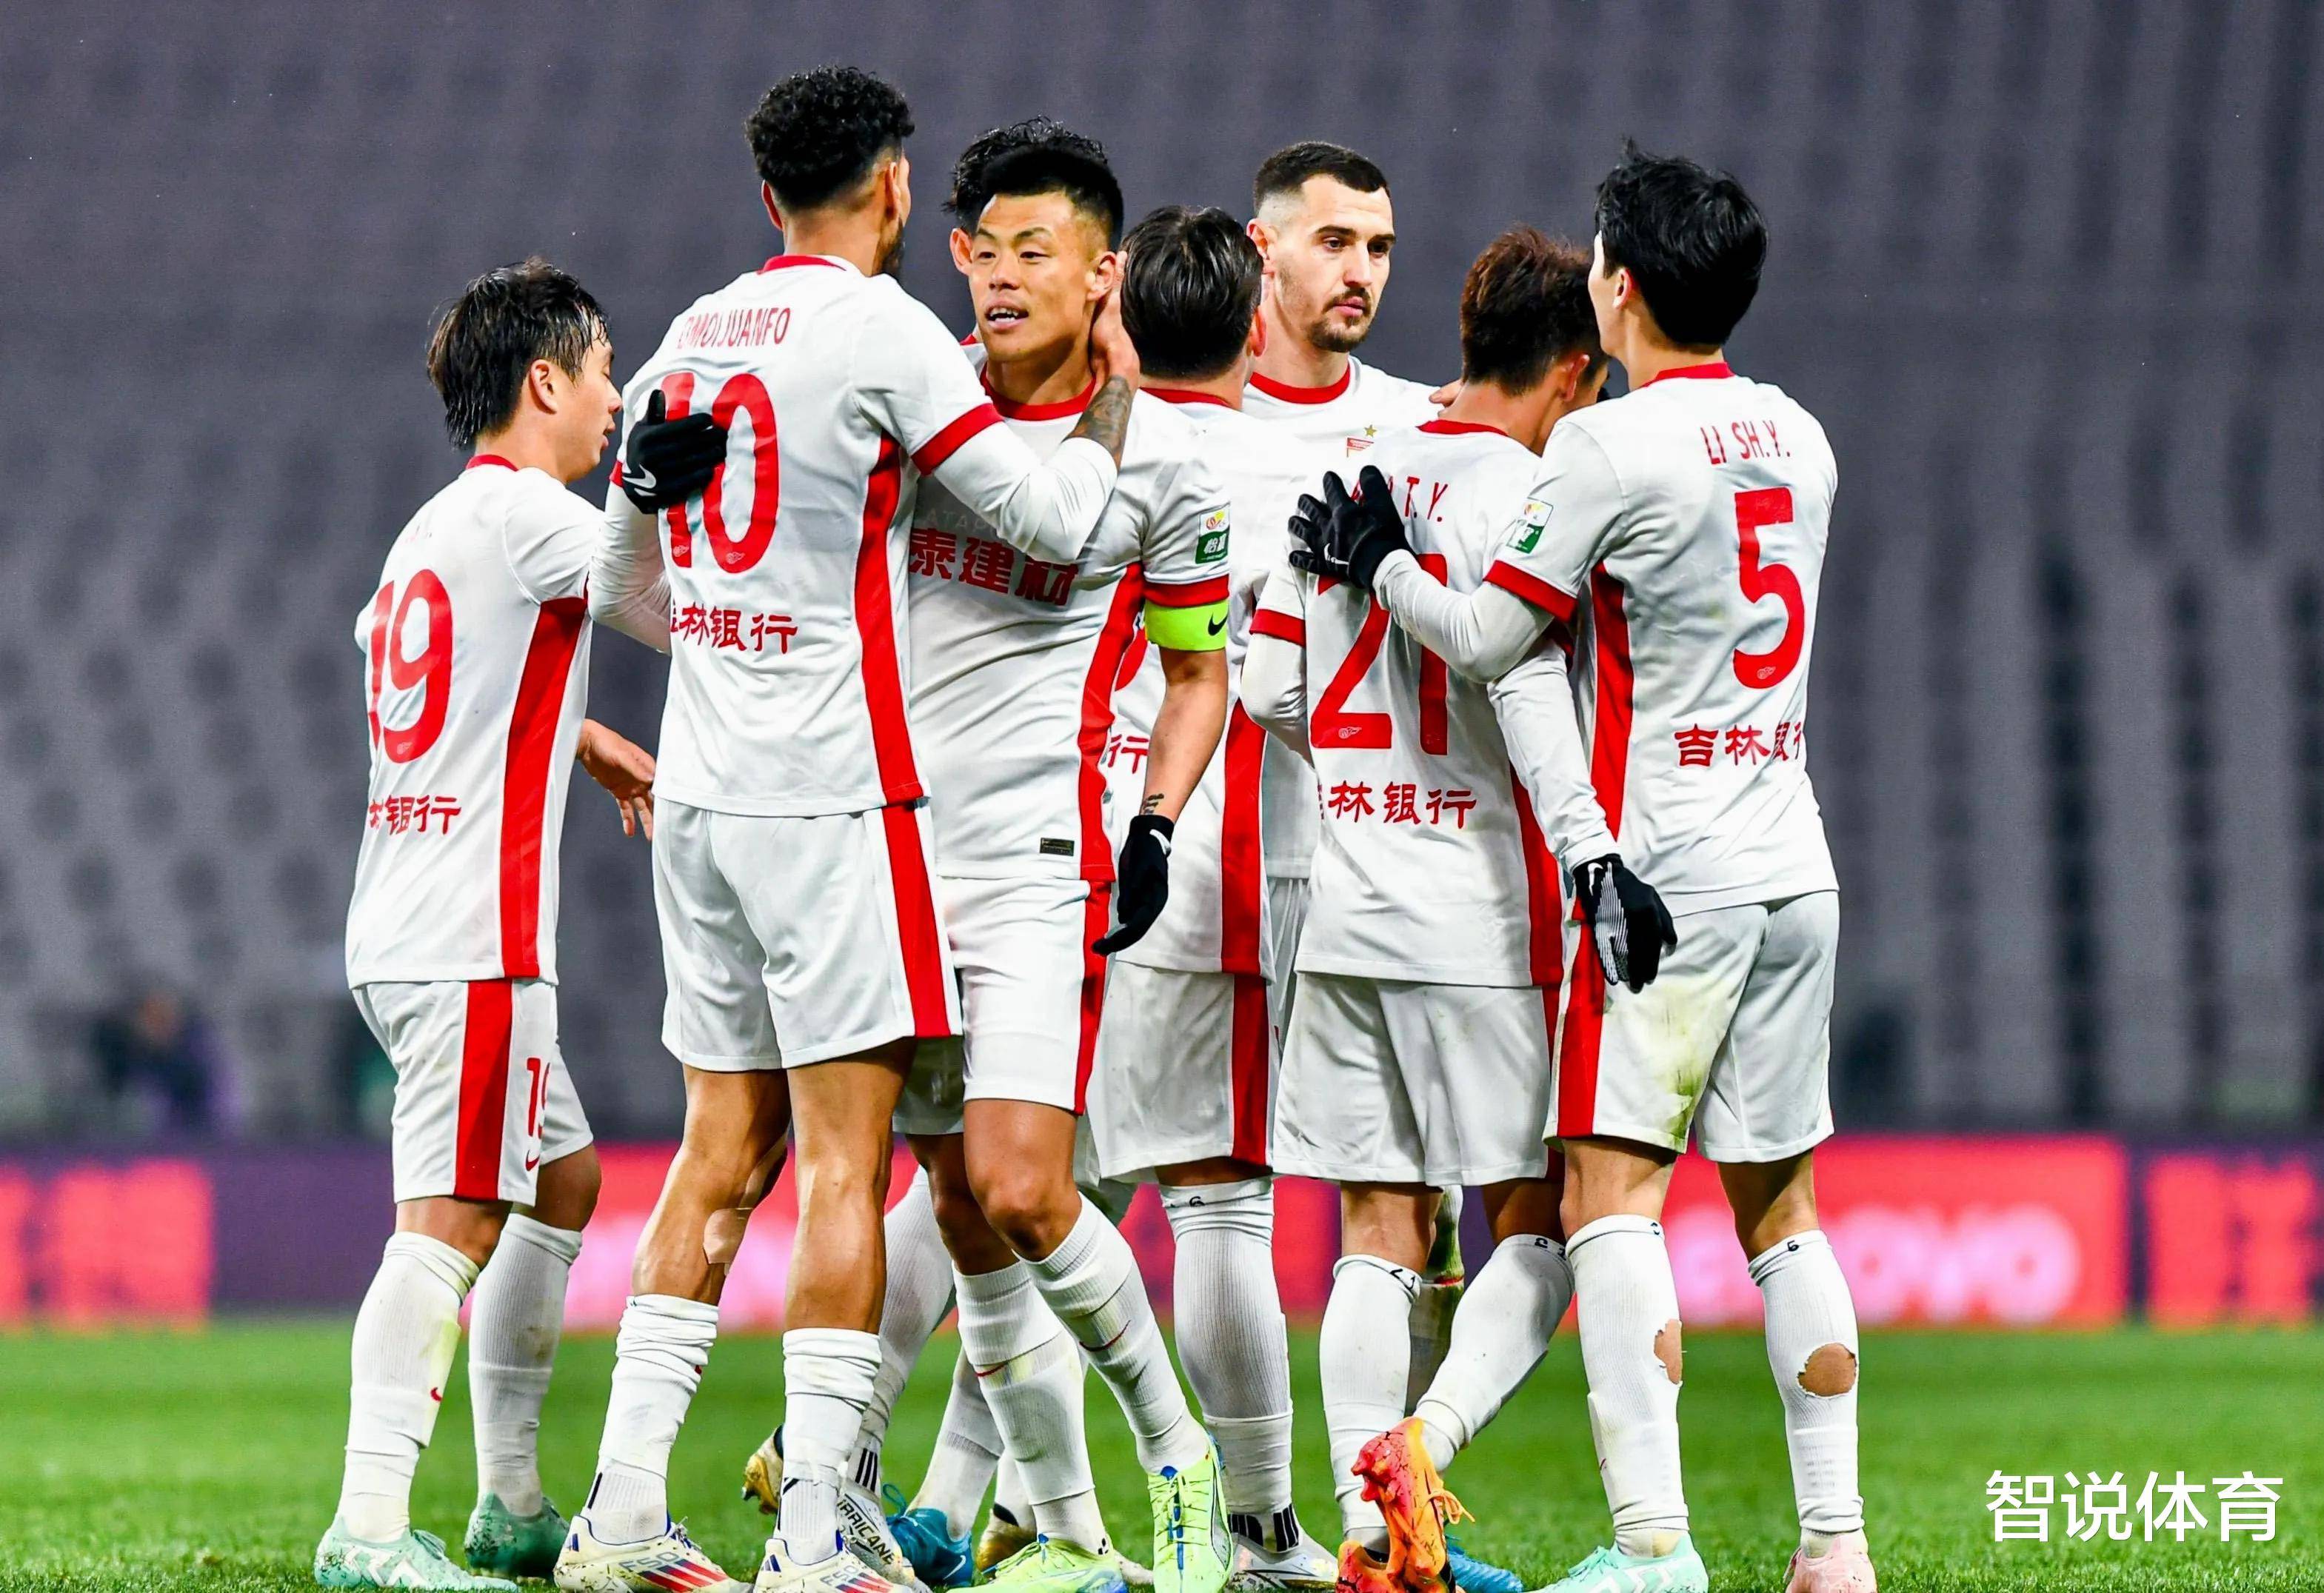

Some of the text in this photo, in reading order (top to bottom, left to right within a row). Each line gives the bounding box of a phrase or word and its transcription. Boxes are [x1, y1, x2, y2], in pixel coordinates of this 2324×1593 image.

[661, 373, 779, 573] 10
[1700, 419, 1791, 465] LI SH.Y.
[368, 569, 453, 764] 19
[1309, 554, 1449, 755] 21
[1732, 487, 1805, 689] 5
[1318, 780, 1477, 829] 林银行
